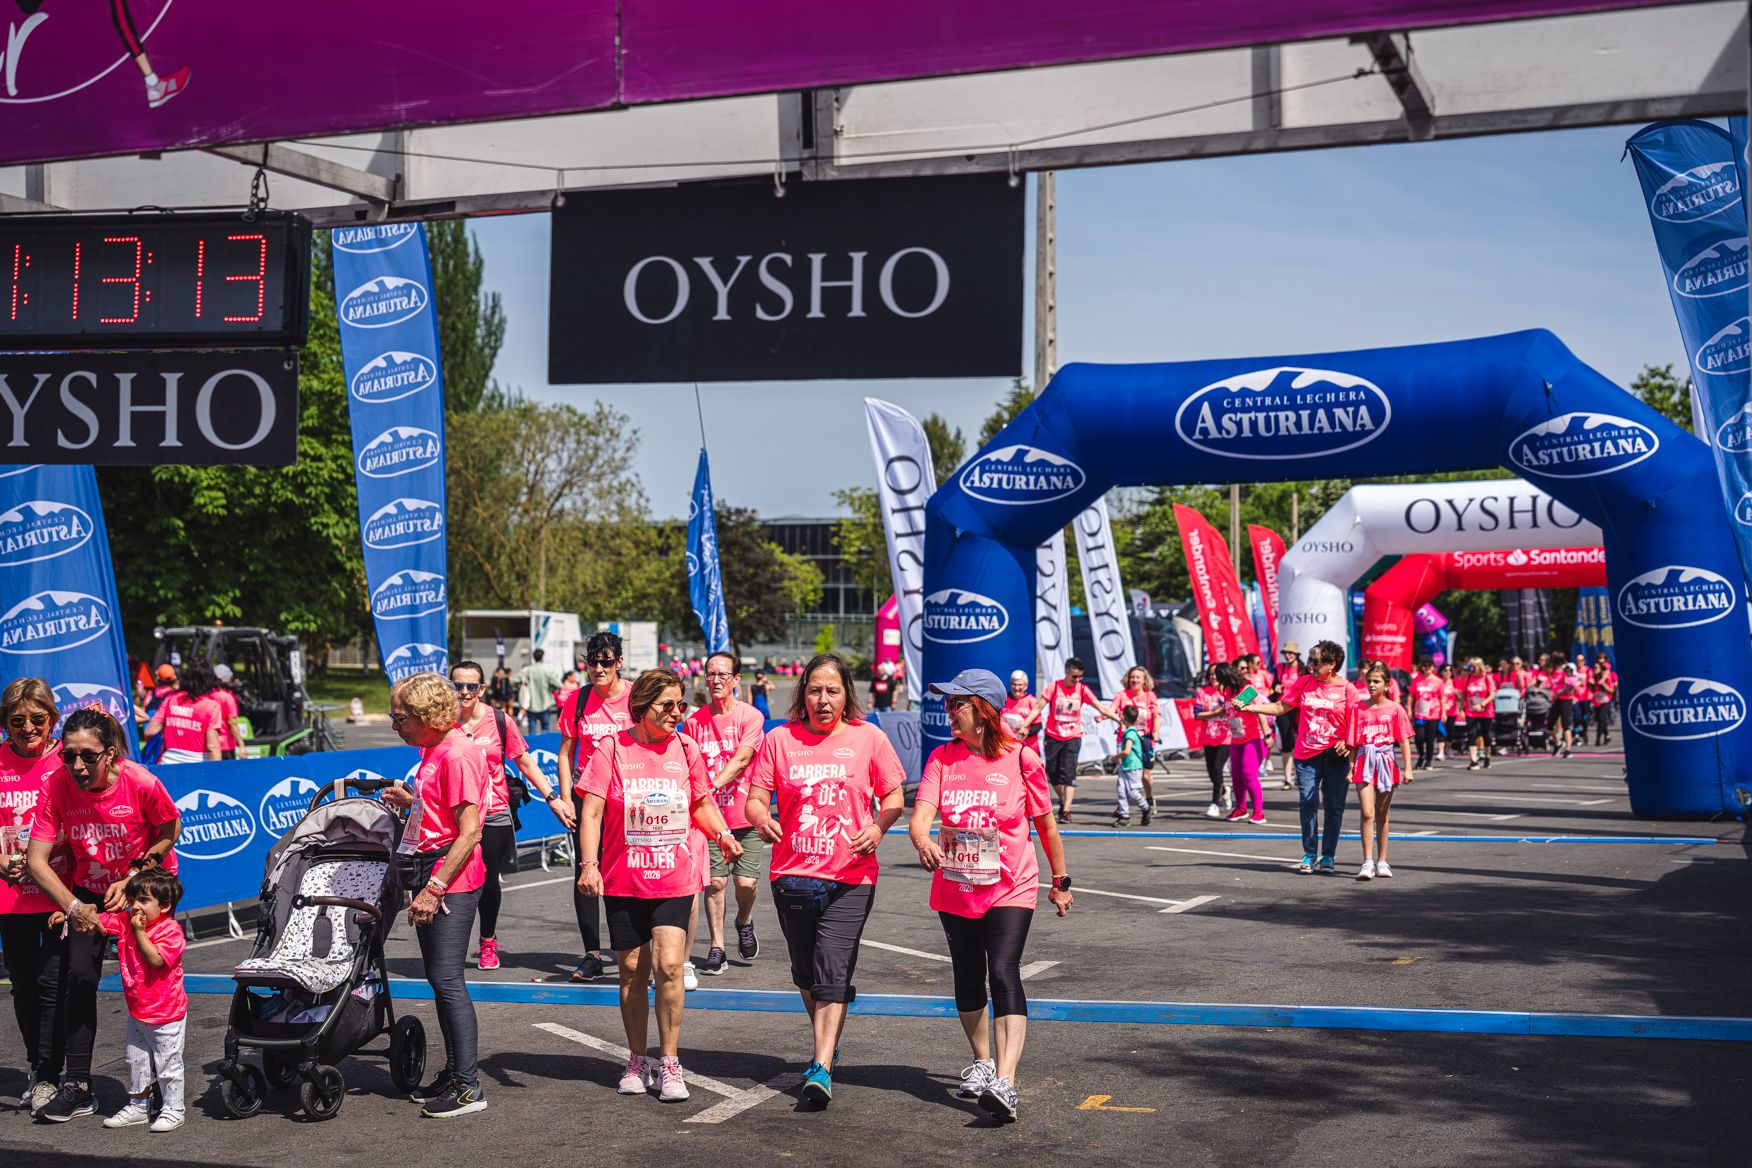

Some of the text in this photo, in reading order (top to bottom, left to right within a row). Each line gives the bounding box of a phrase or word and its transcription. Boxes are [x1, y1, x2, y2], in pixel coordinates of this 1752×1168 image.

[623, 247, 950, 324] OYSHO
[1223, 390, 1367, 408] CENTRAL LECHERA
[0, 369, 277, 450] YSHO
[1192, 401, 1376, 440] ASTURIANA
[1536, 429, 1640, 447] CENTRAL LECHERA
[1522, 436, 1649, 466] ASTURIANA
[985, 464, 1023, 472] CENTRAL
[965, 465, 1075, 490] ASTURIANA
[1302, 541, 1354, 553] OYSHO
[1453, 548, 1606, 570] Sports Santande
[1638, 583, 1725, 596] CENTRAL LECHERA
[1625, 592, 1730, 615] ASTURIANA
[1647, 696, 1736, 707] CENTRAL LECHERA
[1634, 703, 1740, 726] ASTURIANA
[787, 750, 813, 758] OYSHO
[789, 764, 847, 780] CARRERA
[623, 777, 679, 792] CARRERA
[0, 790, 39, 808] CARRE
[819, 784, 836, 806] DE
[942, 789, 998, 808] CARRERA
[181, 809, 243, 824] CENTRAL LECHERA
[646, 815, 669, 825] 016
[70, 822, 129, 840] CARRERA
[105, 842, 124, 861] DE
[791, 836, 835, 855] MUJER
[627, 851, 675, 869] MUJER
[957, 853, 979, 863] 016
[643, 870, 661, 880] 2026
